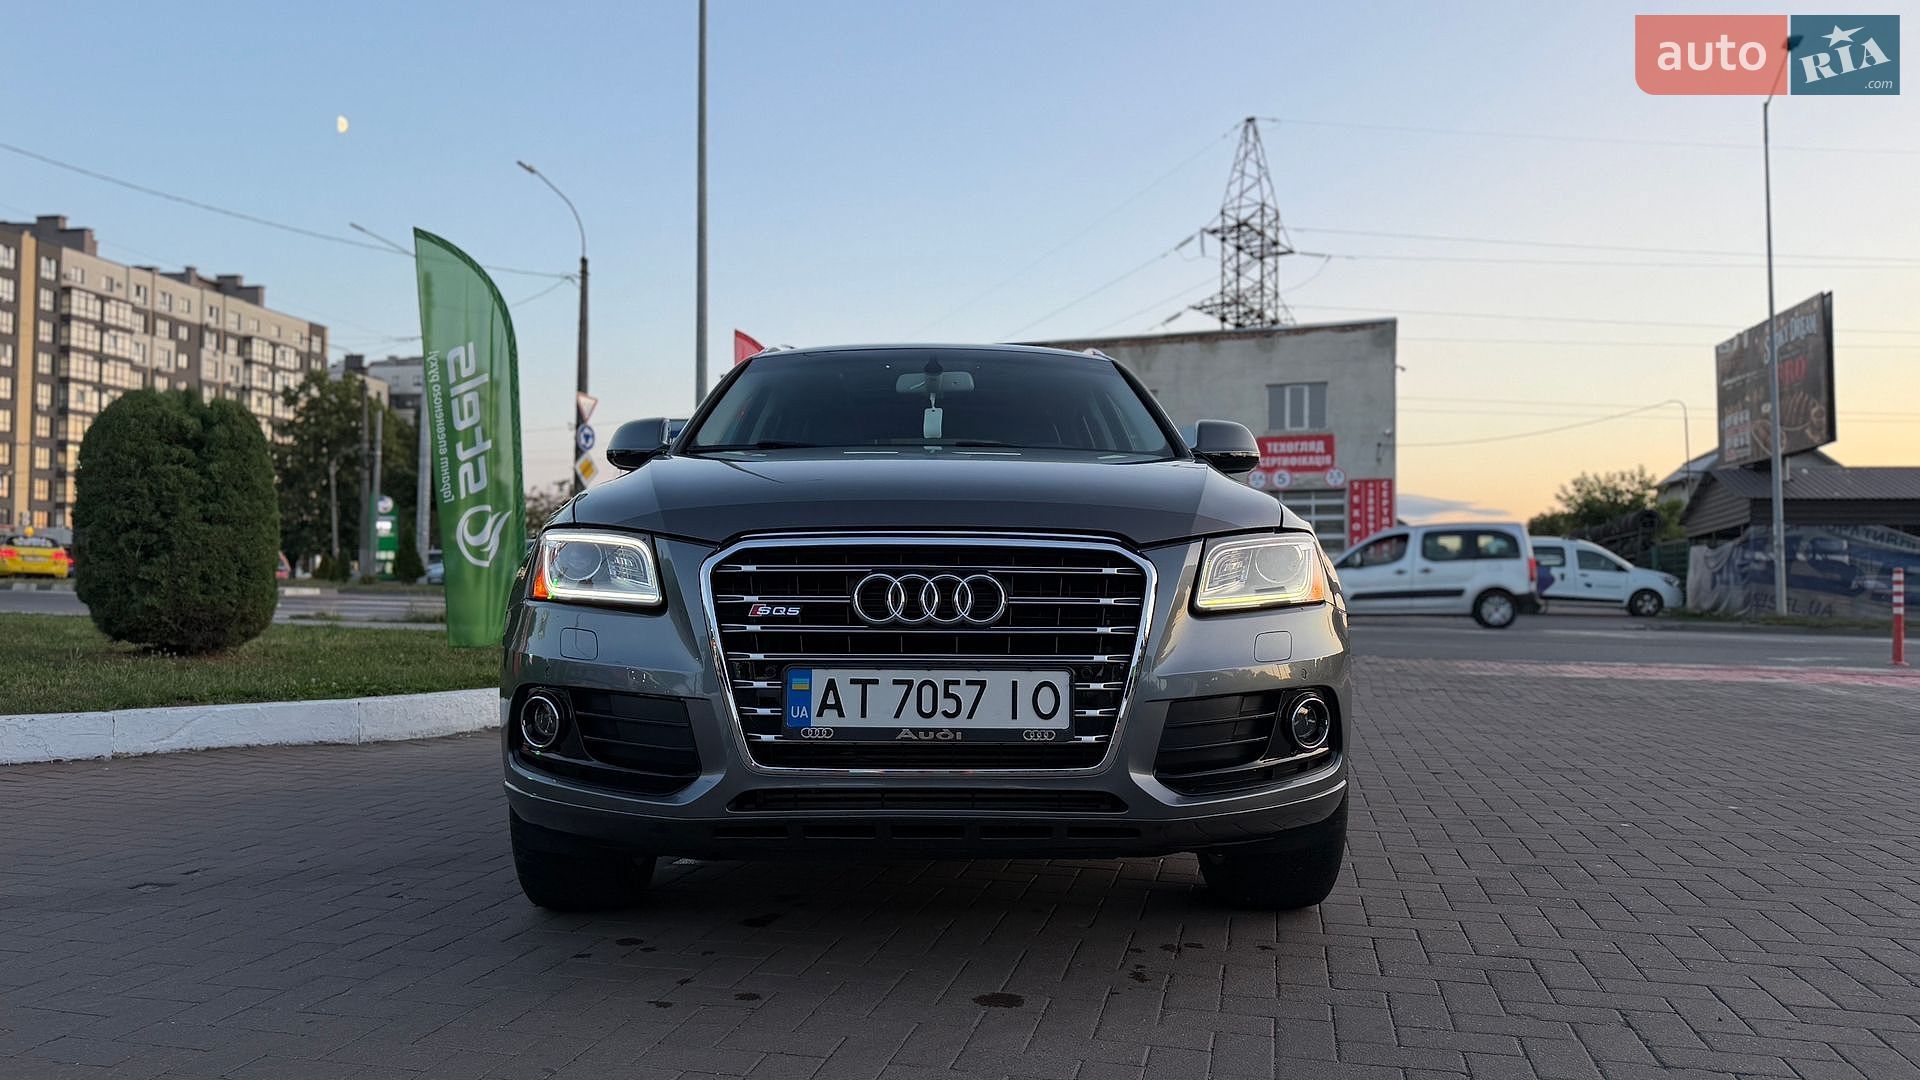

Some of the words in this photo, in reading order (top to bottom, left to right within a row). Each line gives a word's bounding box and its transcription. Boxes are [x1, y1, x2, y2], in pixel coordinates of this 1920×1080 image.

[1267, 440, 1325, 454] ТЕХОГЛЯД
[756, 605, 800, 616] SQ5
[815, 677, 880, 719] AT
[891, 679, 988, 720] 7057
[1011, 679, 1061, 720] IO
[790, 705, 809, 719] UA
[895, 728, 962, 741] Audi
